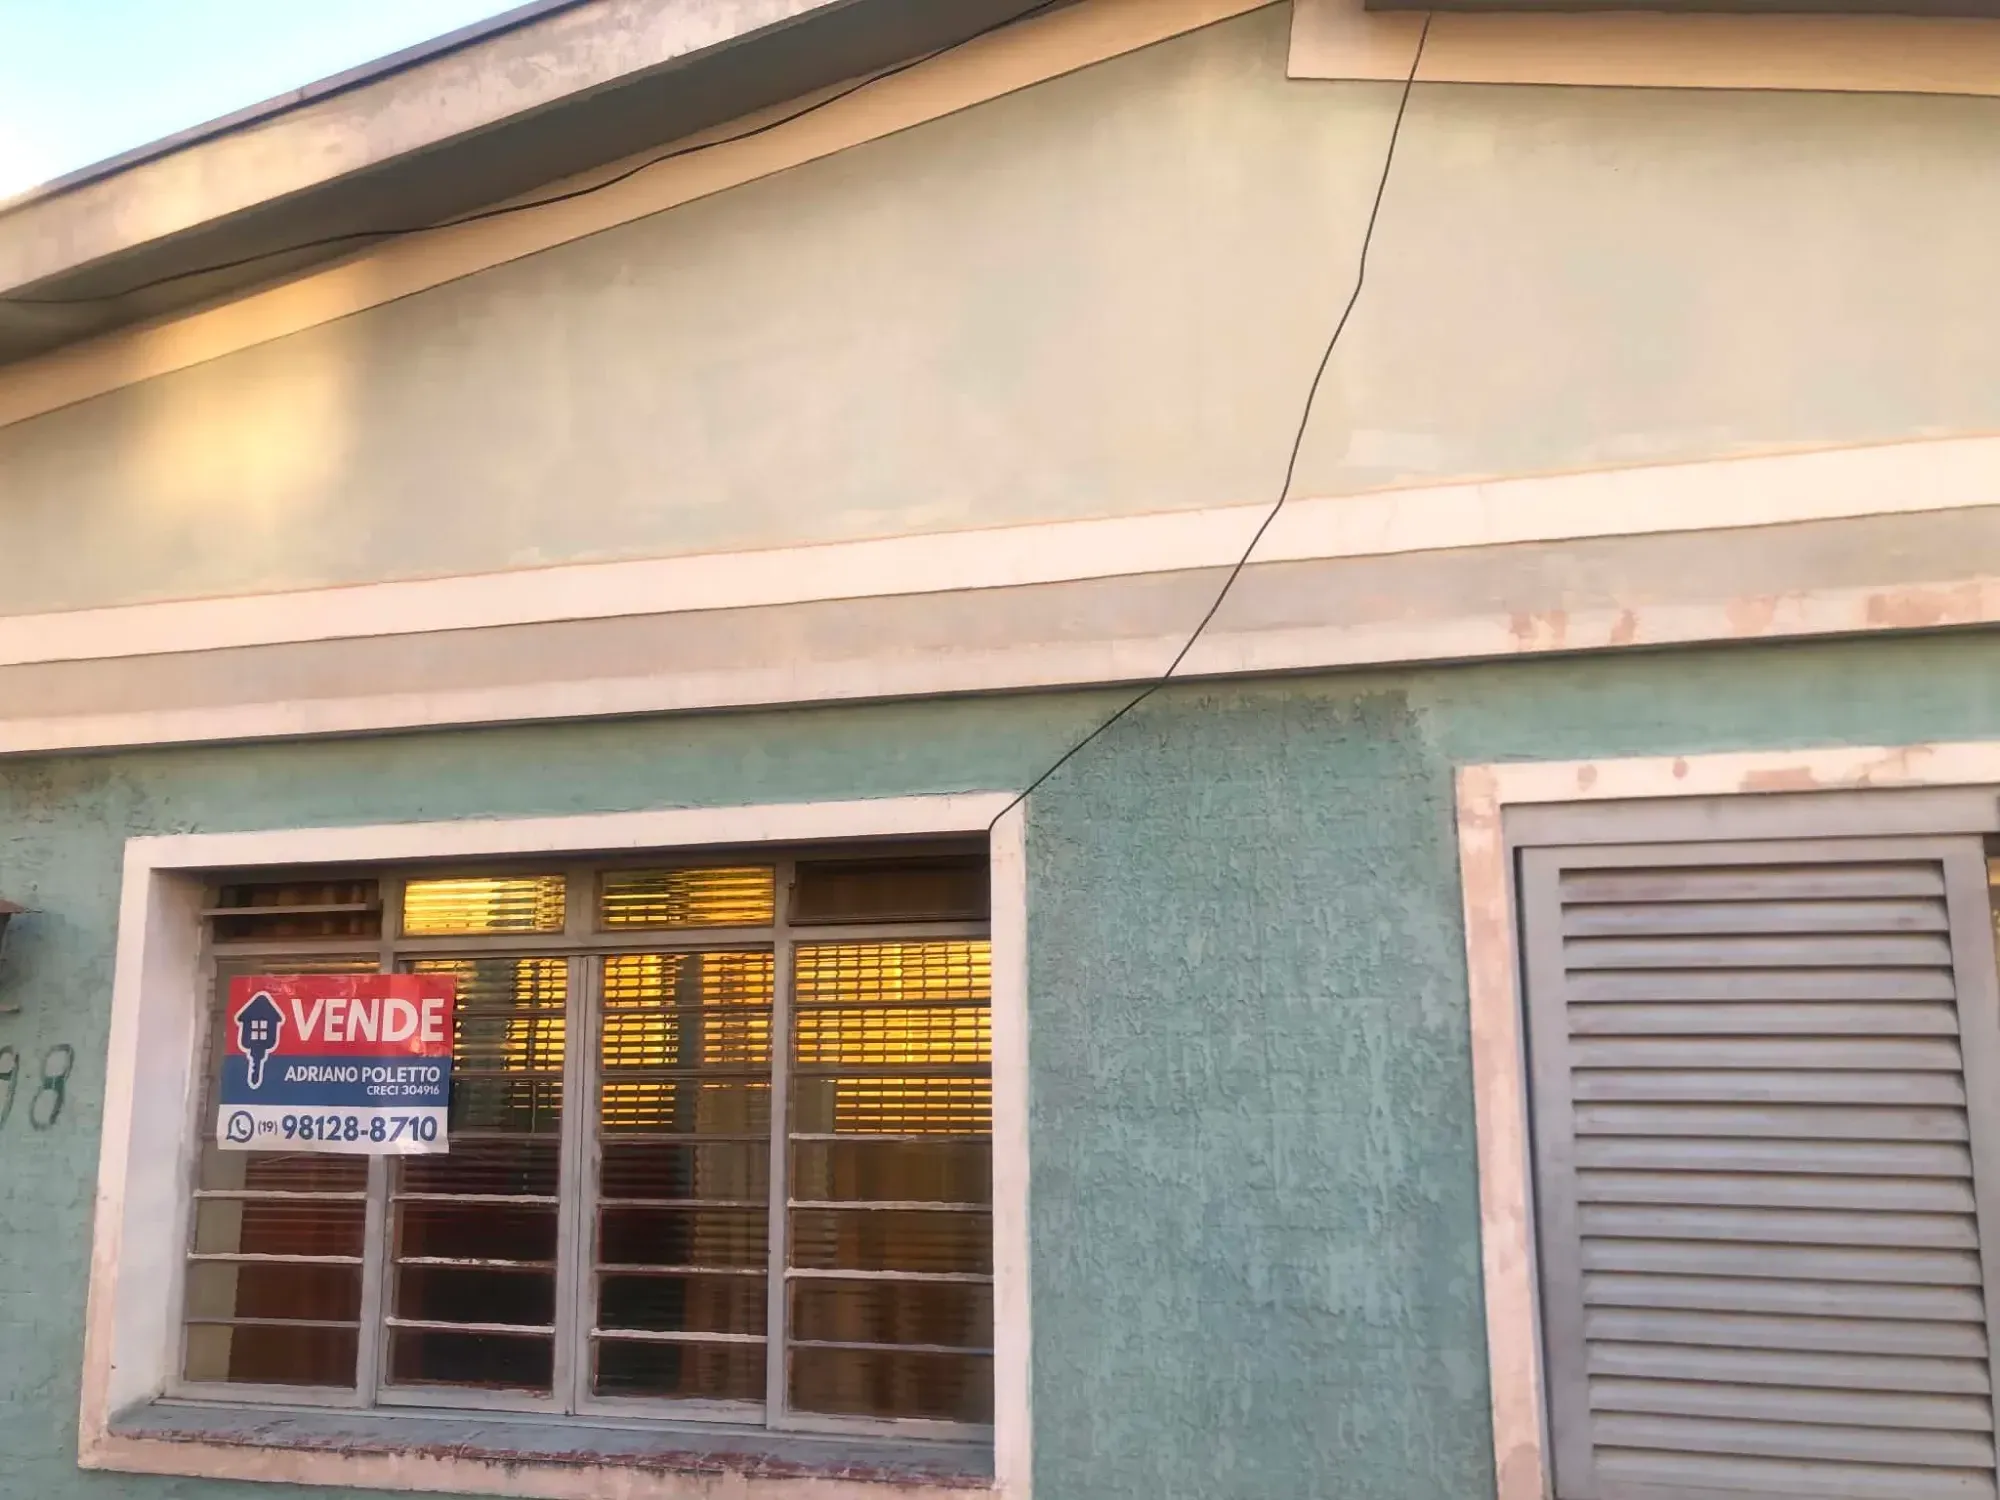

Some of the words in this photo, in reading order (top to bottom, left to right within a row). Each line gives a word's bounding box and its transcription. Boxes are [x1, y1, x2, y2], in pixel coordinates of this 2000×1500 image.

[290, 998, 445, 1042] VENDE
[284, 1065, 358, 1083] ADRIANO
[361, 1066, 441, 1083] POLETTO
[366, 1085, 399, 1096] CRECI
[401, 1085, 440, 1095] 304916
[257, 1120, 278, 1136] (19)
[281, 1114, 438, 1142] 98128-8710
